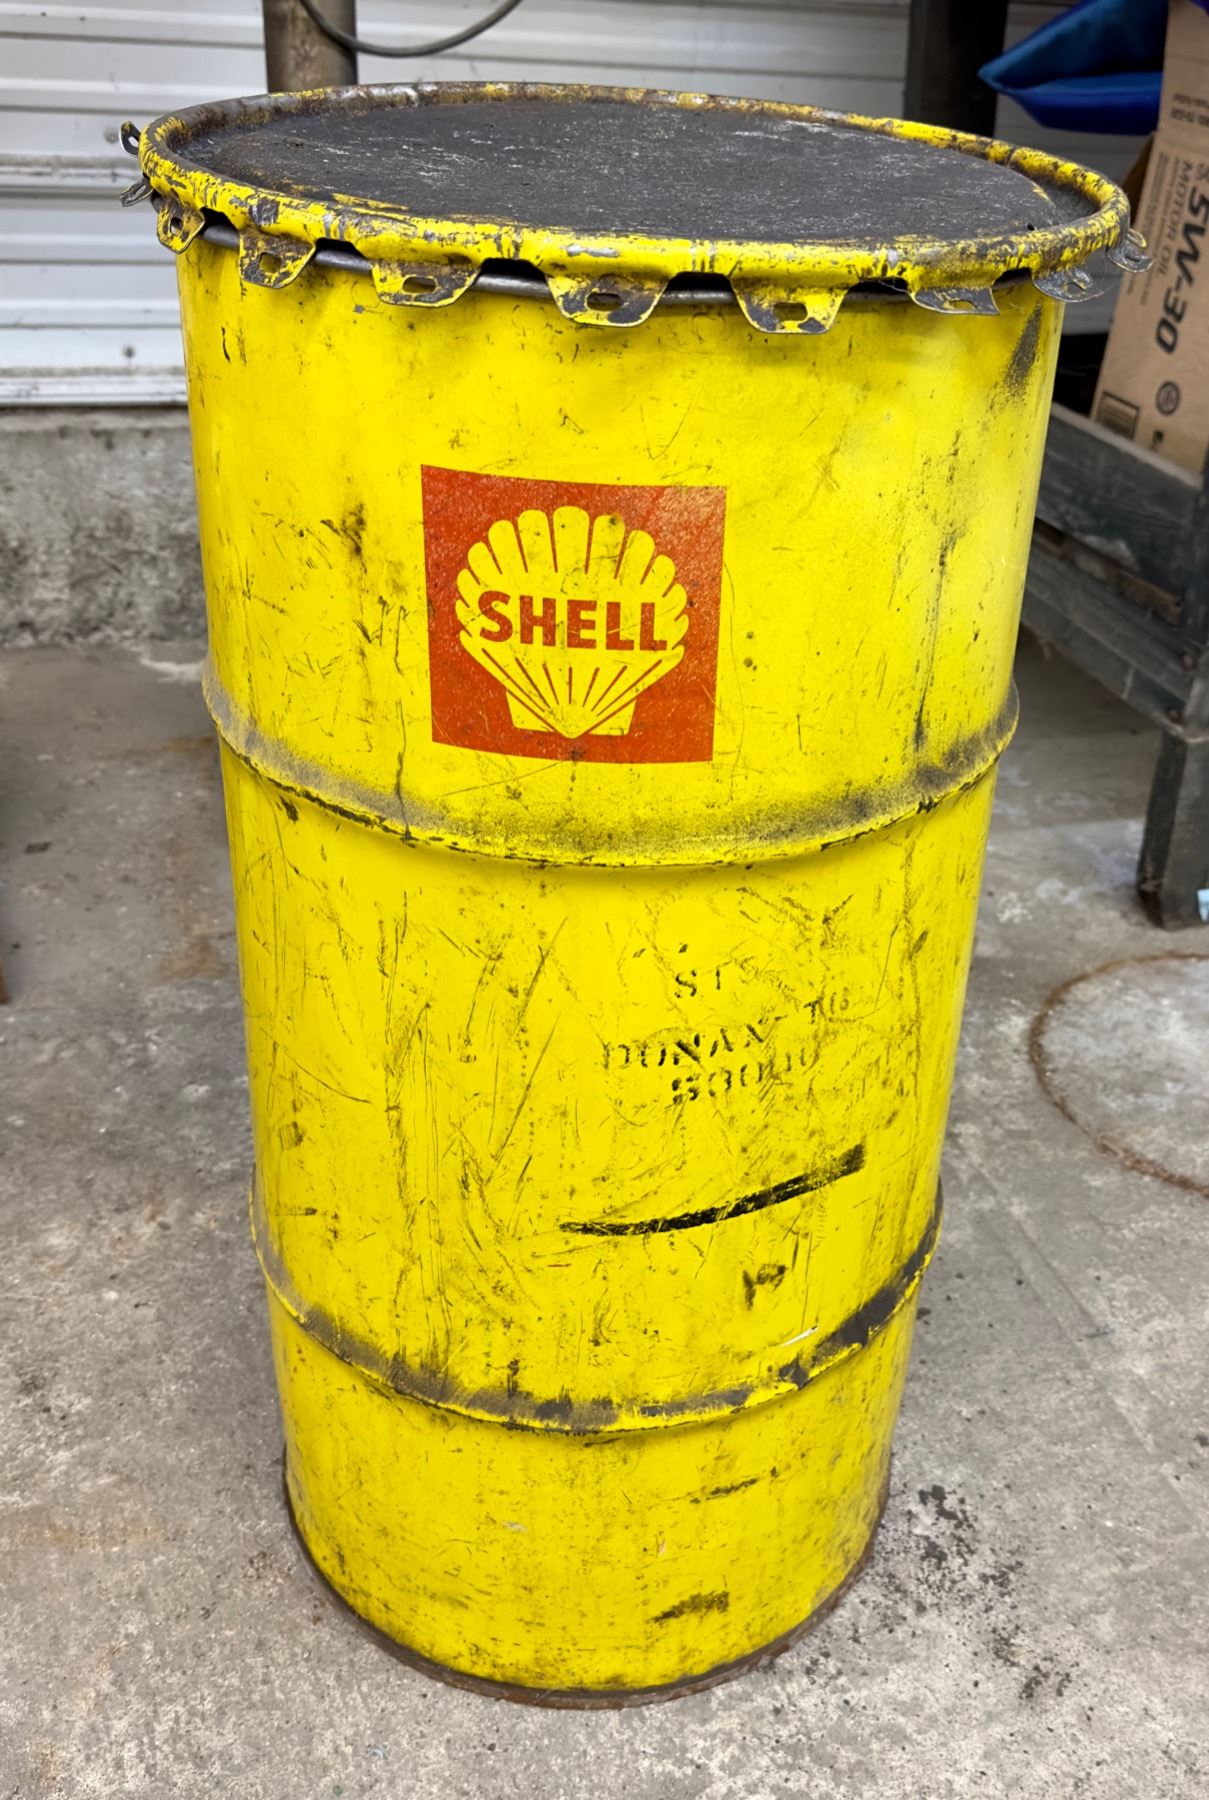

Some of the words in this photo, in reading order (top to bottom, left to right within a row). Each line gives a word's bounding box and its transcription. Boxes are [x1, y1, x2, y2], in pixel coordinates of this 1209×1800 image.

[1165, 159, 1193, 242] MOTOR
[1154, 246, 1173, 276] OIL
[477, 590, 668, 651] SHELL
